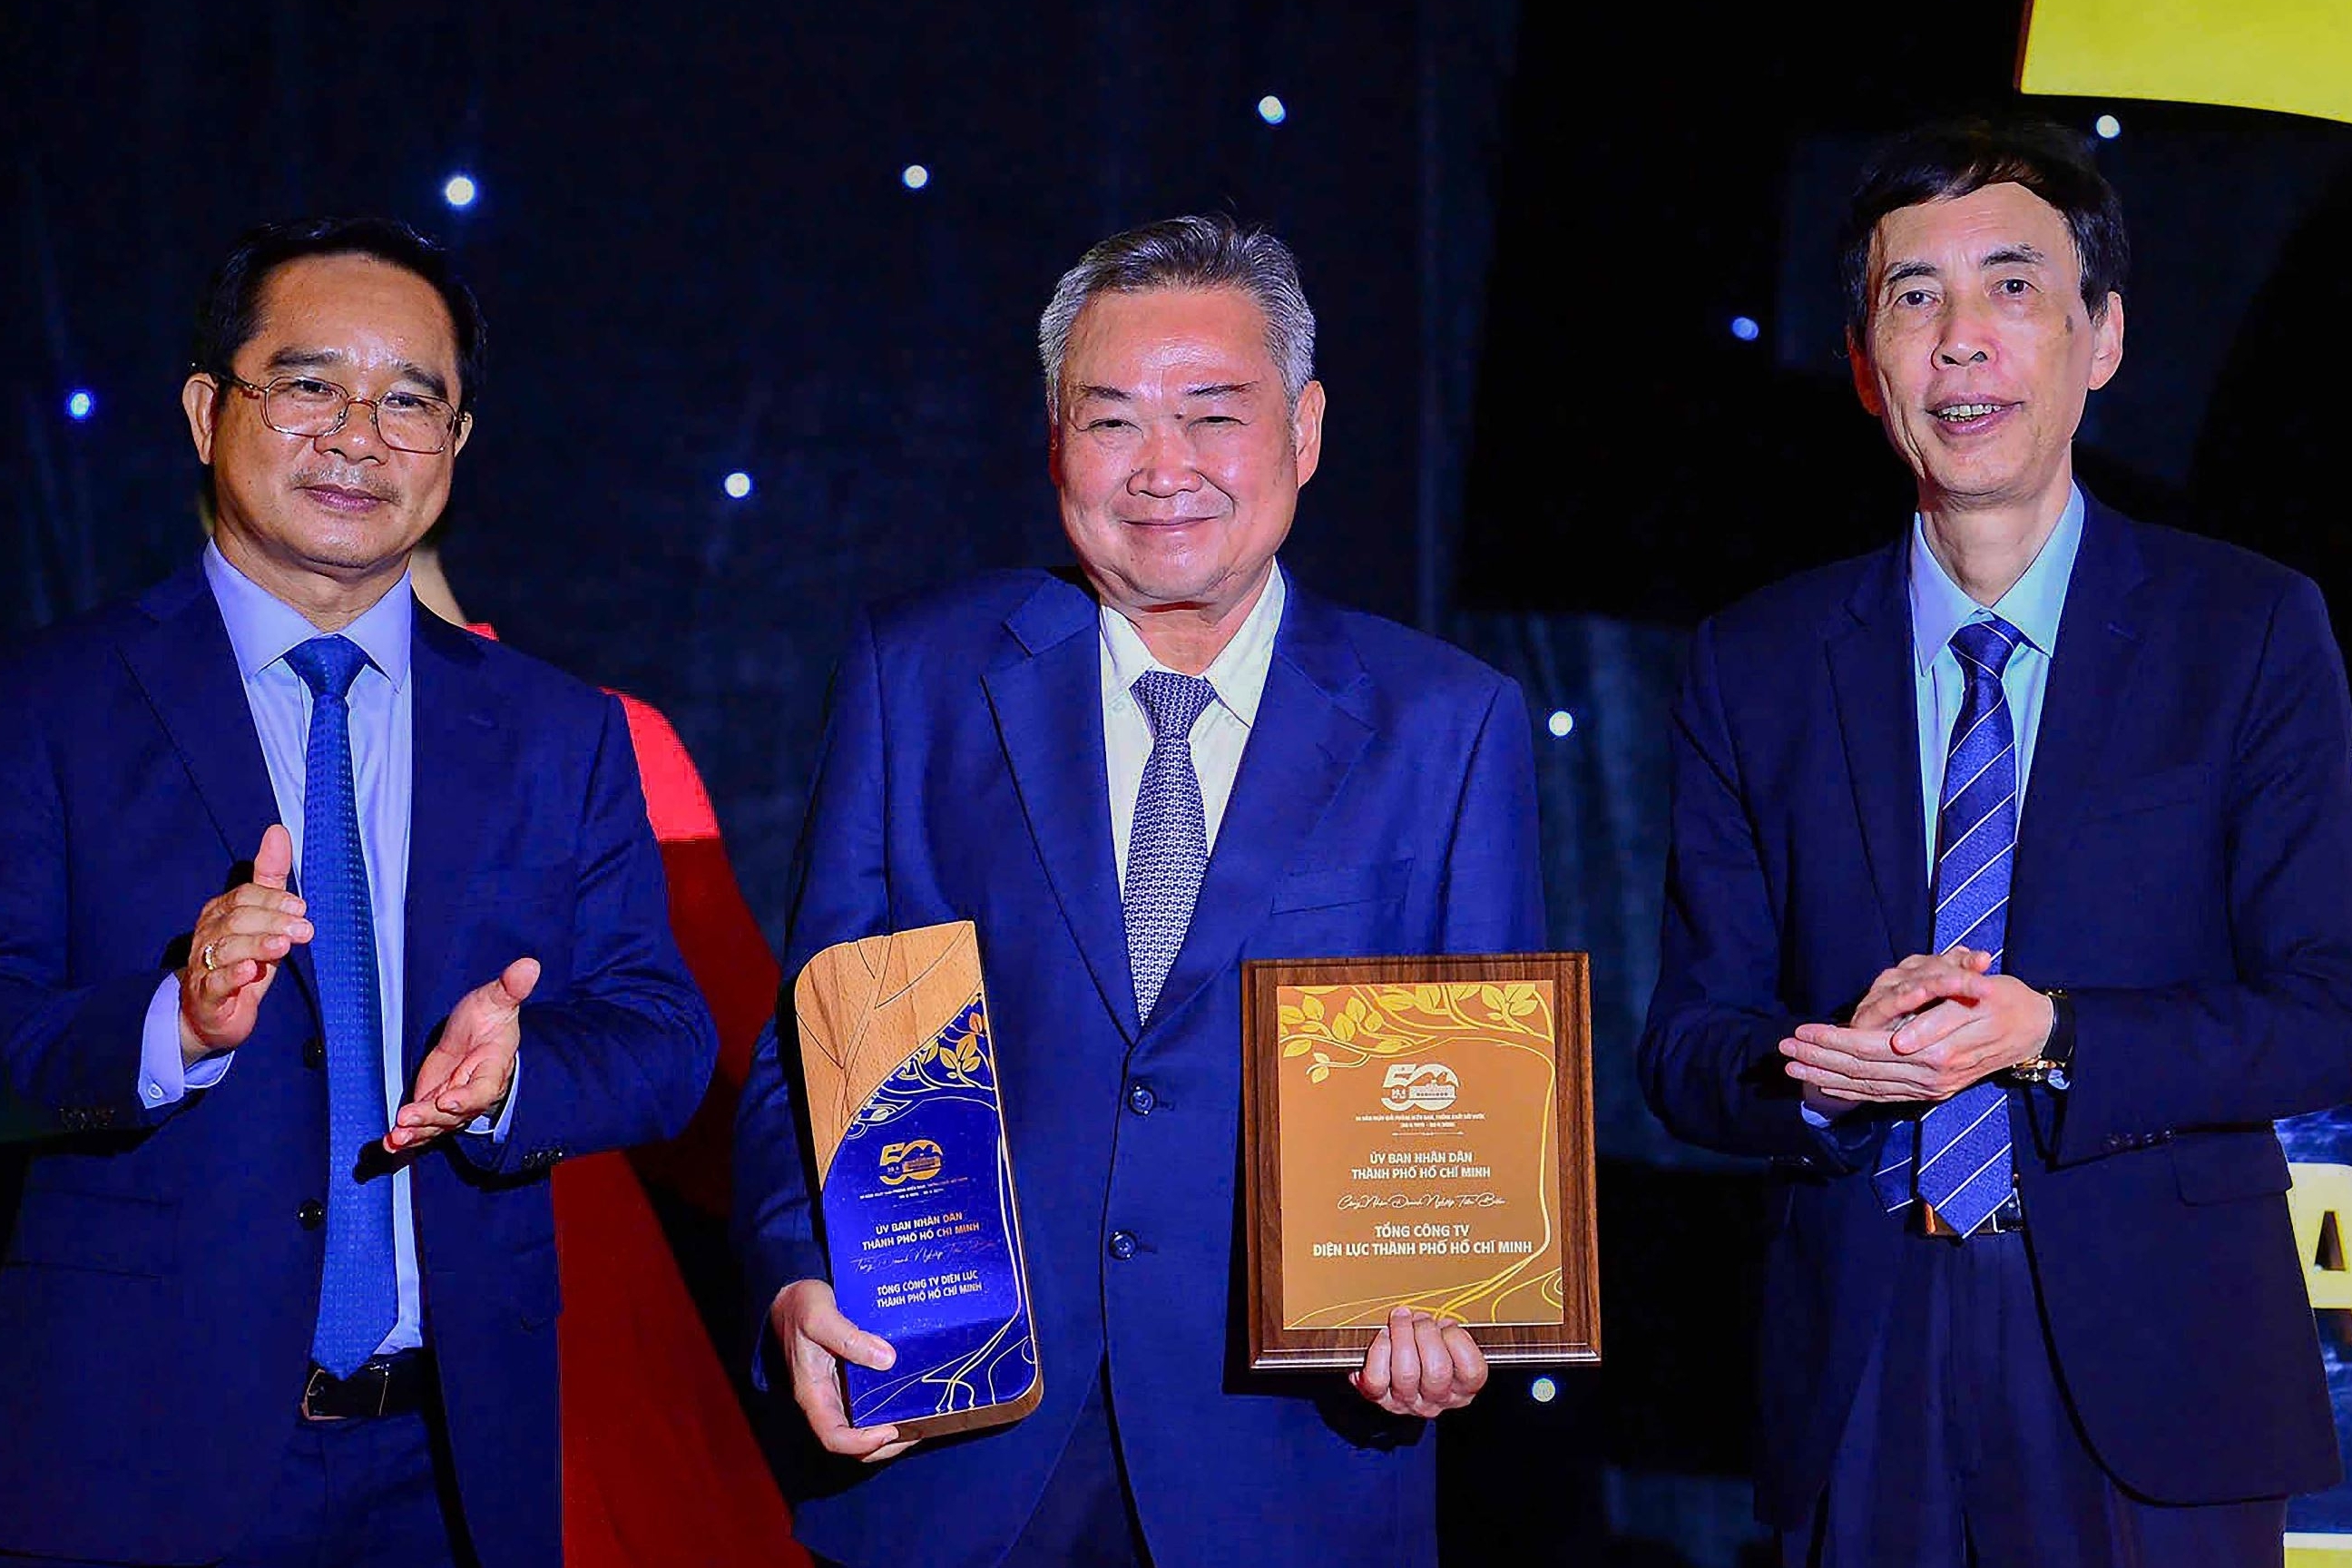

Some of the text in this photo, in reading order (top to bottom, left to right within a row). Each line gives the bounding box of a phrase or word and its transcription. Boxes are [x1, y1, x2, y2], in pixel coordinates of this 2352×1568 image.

[1388, 1153, 1411, 1164] BAN
[1415, 1152, 1446, 1163] NHÂN
[1449, 1151, 1473, 1162] DÂN
[1351, 1167, 1389, 1180] THÀNH
[1461, 1166, 1491, 1178] MINH
[892, 1220, 911, 1232] BAN
[955, 1221, 980, 1234] MINH
[1414, 1223, 1450, 1237] CÔNG
[1453, 1224, 1470, 1237] TY
[1372, 1240, 1416, 1256] THÀNH
[1498, 1240, 1532, 1253] MINH
